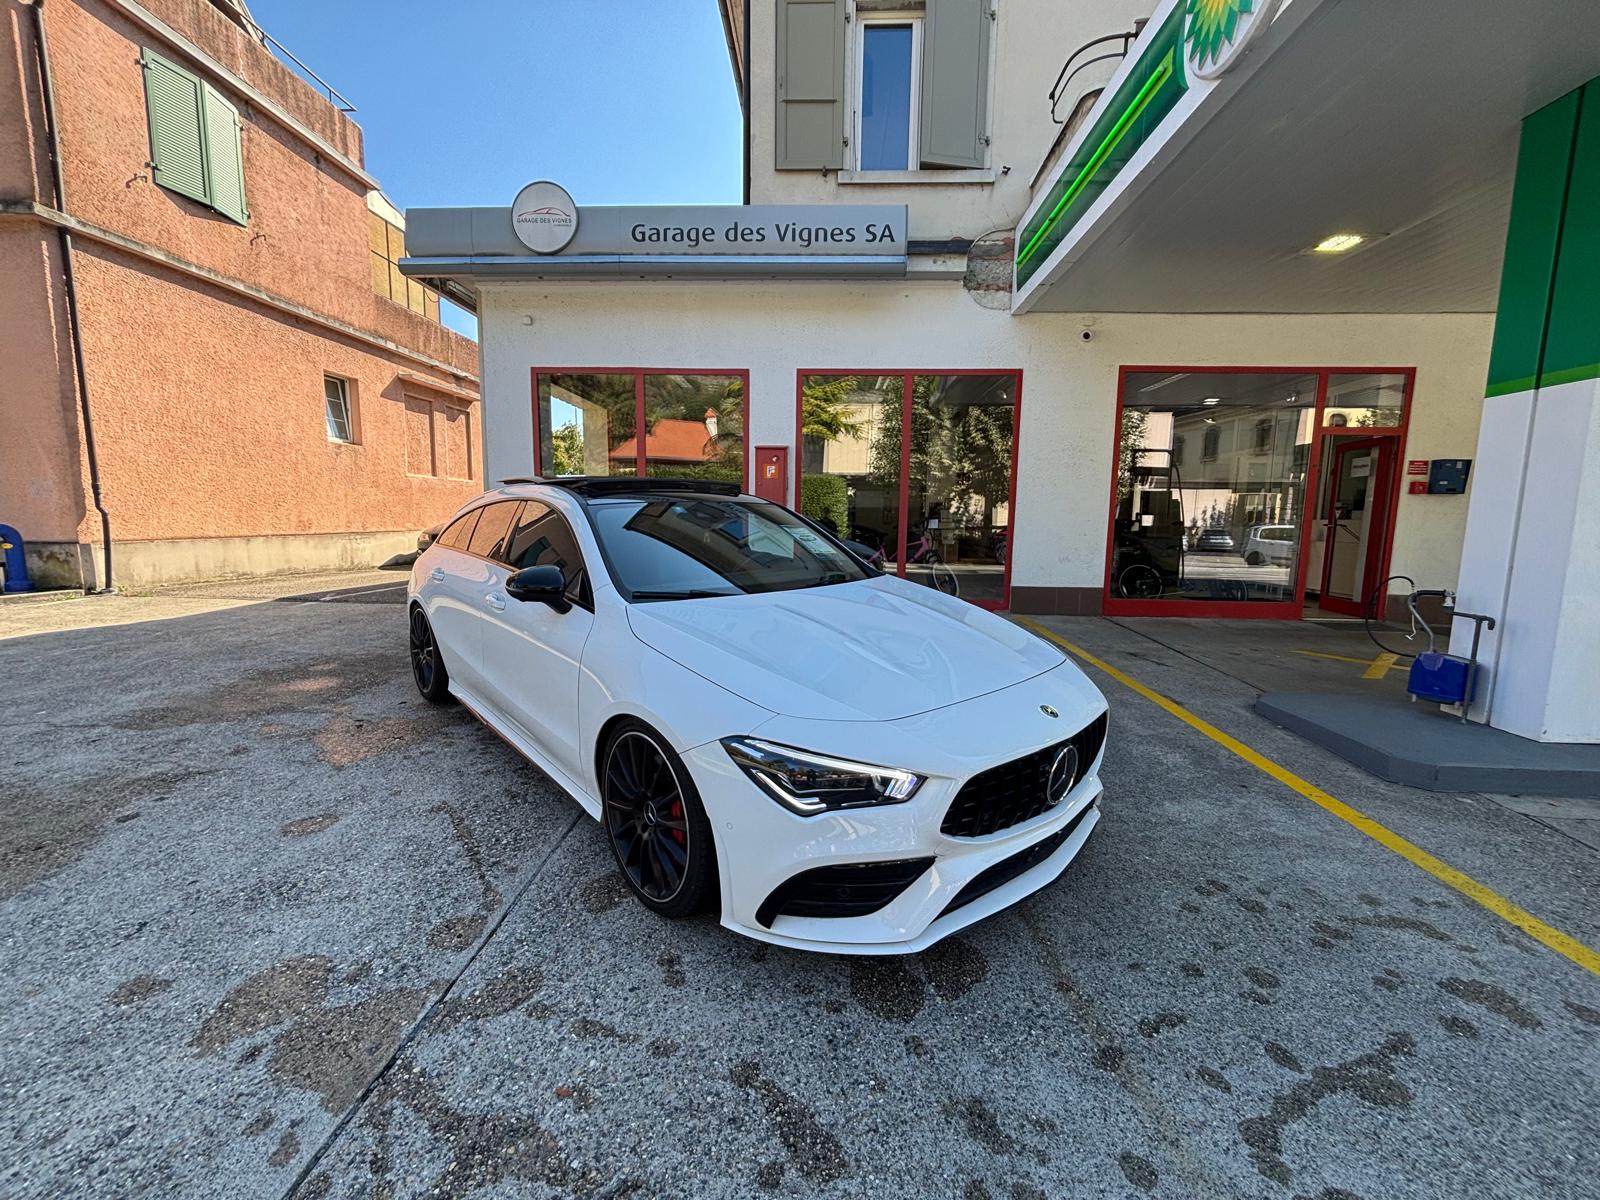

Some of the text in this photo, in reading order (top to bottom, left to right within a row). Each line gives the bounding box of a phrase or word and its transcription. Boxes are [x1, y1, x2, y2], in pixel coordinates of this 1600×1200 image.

[631, 221, 896, 248] Garage des Vignes SA
